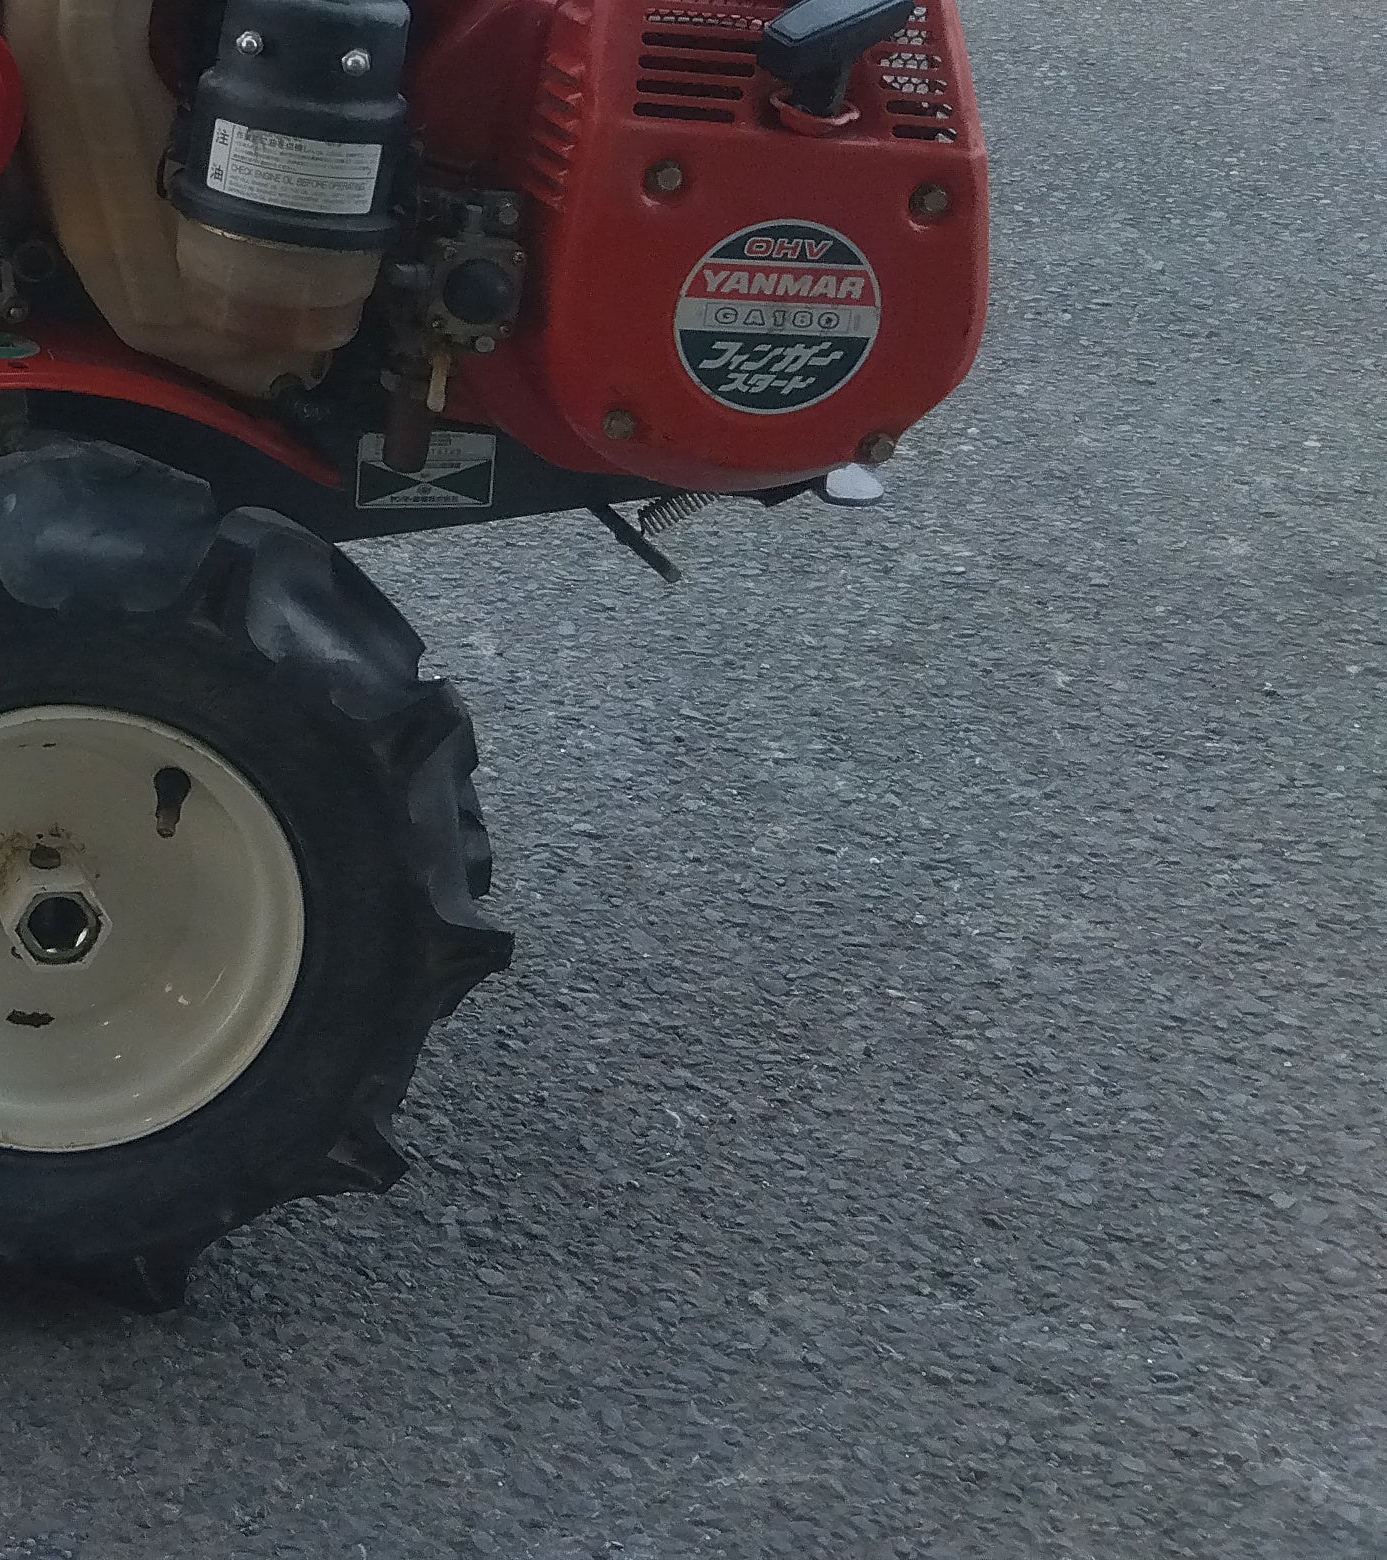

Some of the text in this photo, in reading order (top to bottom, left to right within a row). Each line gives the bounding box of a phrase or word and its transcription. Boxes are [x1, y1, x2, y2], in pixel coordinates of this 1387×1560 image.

[744, 237, 833, 260] OHV
[702, 269, 865, 299] YANMAR
[698, 341, 844, 373] フィンガー
[717, 373, 816, 395] スタート
